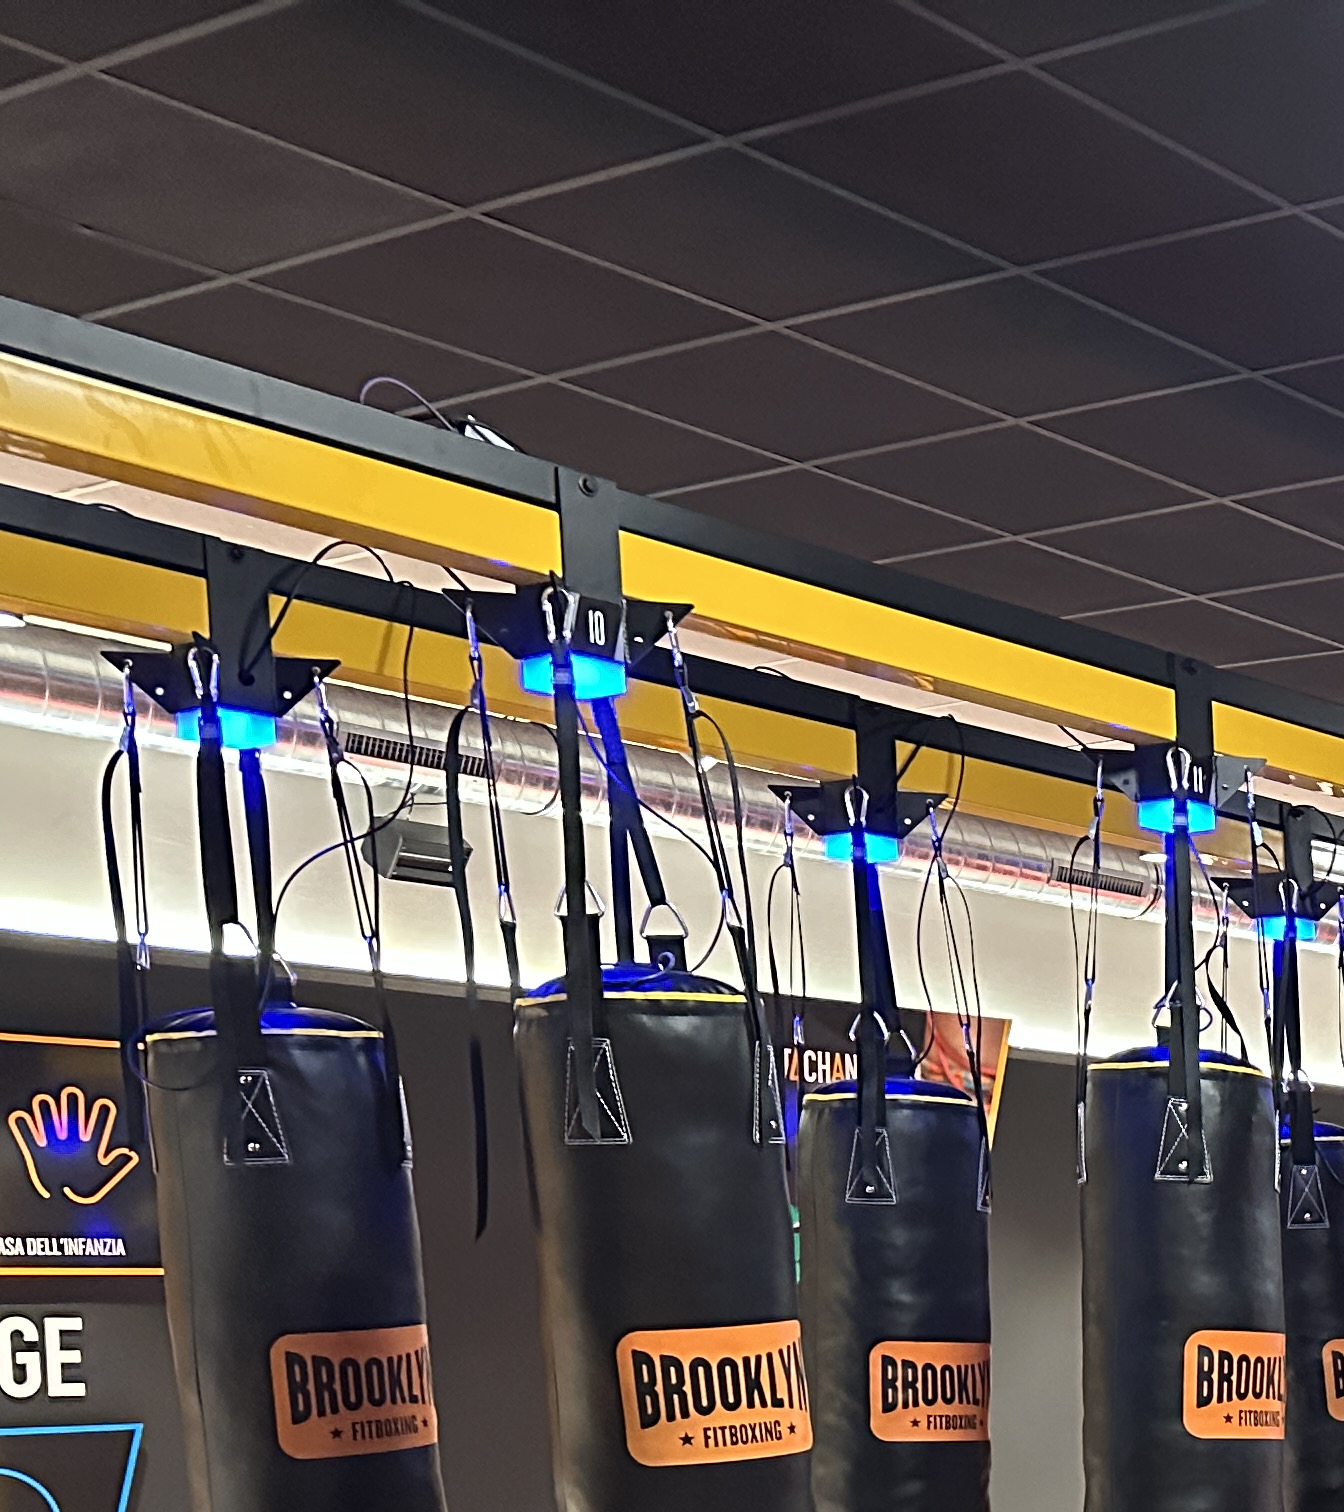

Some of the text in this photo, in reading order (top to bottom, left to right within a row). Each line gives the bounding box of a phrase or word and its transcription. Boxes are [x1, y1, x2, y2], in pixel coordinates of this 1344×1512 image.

[26, 1237, 126, 1256] DELL'INFANZIA
[352, 1415, 419, 1441] FITBOXING
[702, 1420, 783, 1449] FITBOXING
